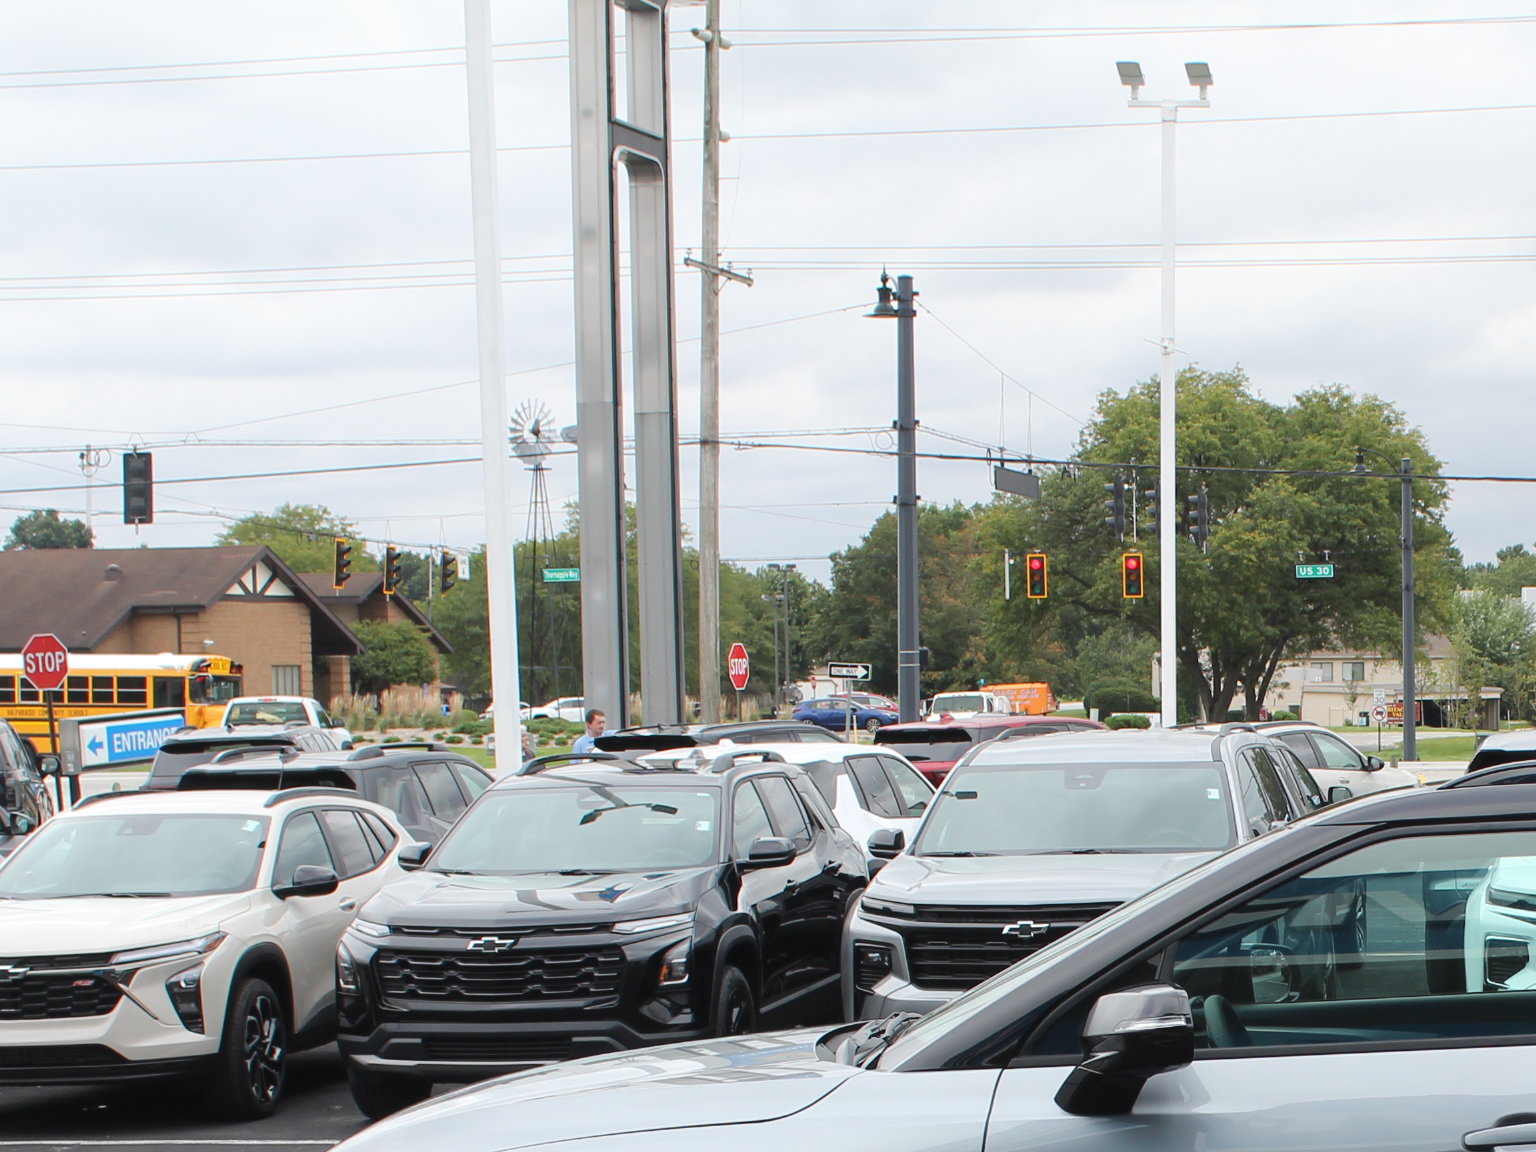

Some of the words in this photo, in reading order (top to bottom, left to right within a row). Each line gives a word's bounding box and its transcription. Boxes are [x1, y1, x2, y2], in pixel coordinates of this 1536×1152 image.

[1300, 566, 1313, 576] US
[1316, 566, 1329, 576] 30
[26, 651, 65, 674] STOP
[730, 658, 748, 676] STOP
[1374, 696, 1385, 704] 30
